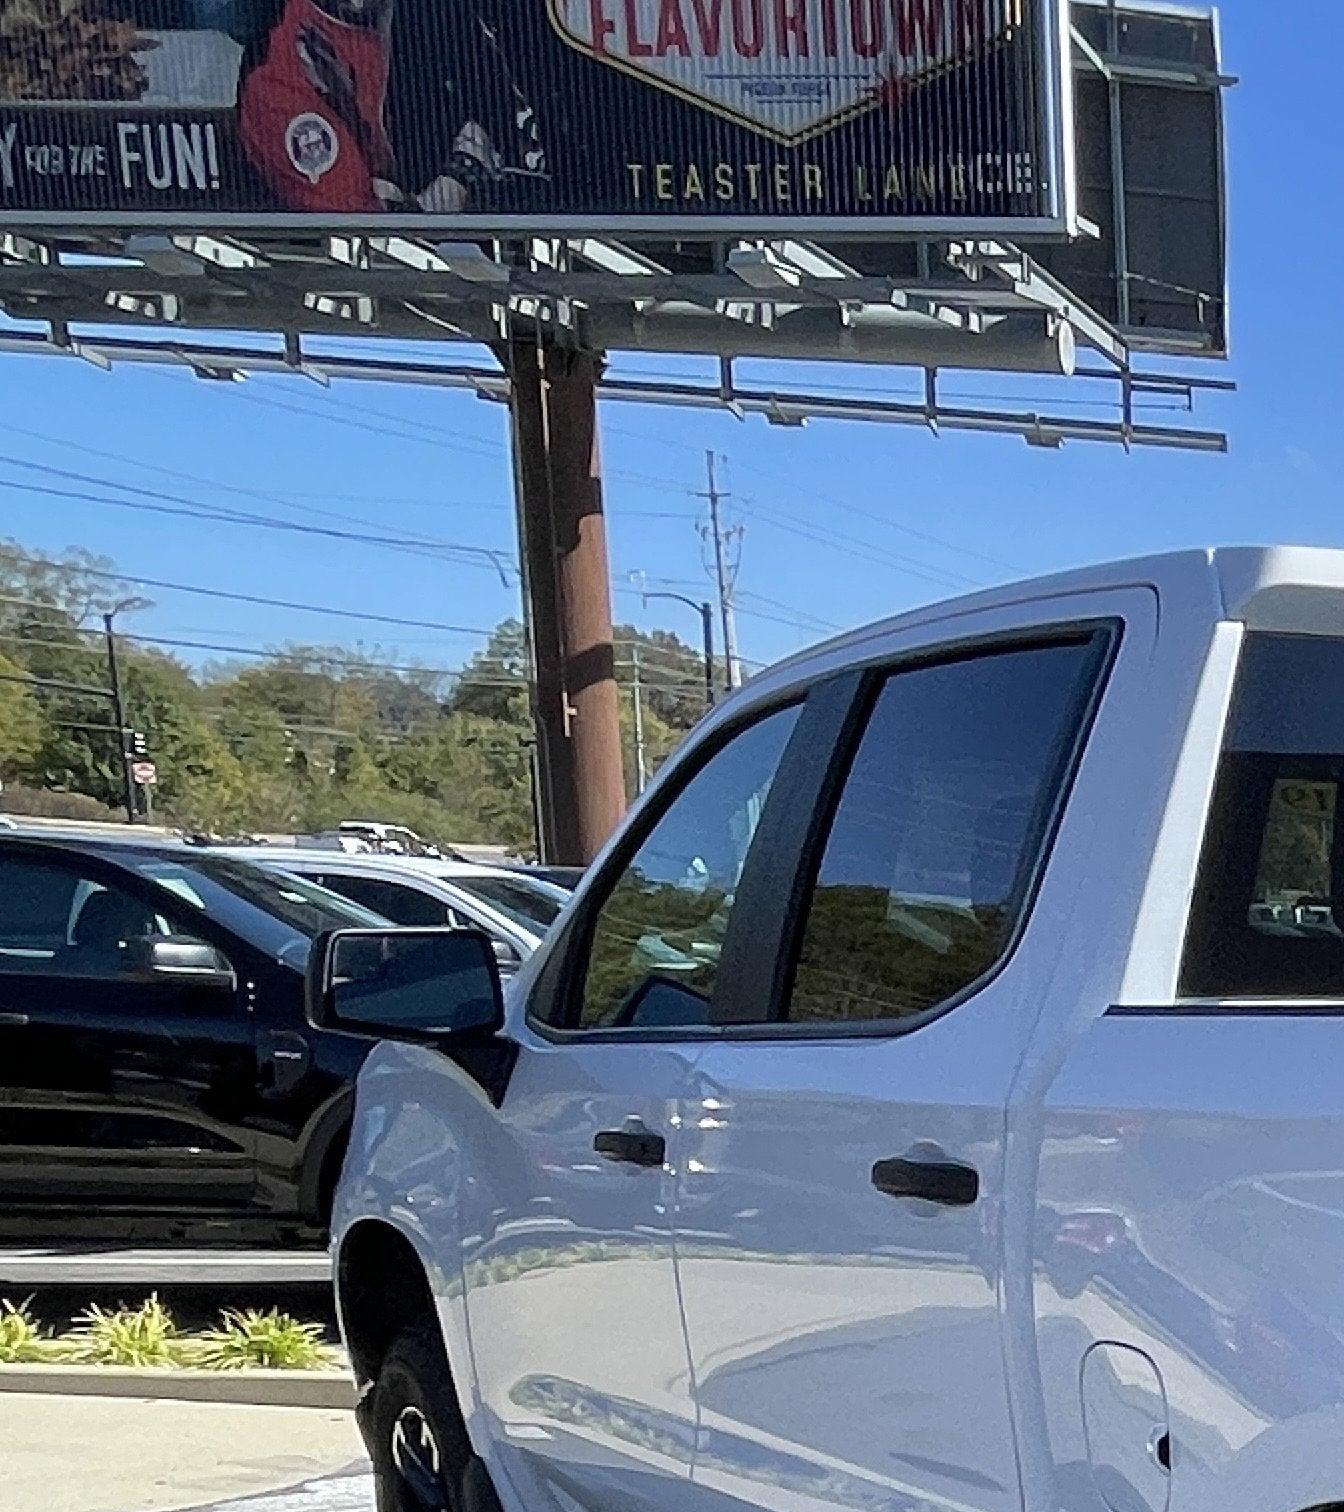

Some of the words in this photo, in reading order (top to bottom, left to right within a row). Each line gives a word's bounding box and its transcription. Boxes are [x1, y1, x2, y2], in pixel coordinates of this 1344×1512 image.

[68, 144, 106, 175] THE
[117, 122, 220, 190] FUN!
[628, 163, 824, 200] TEASTER
